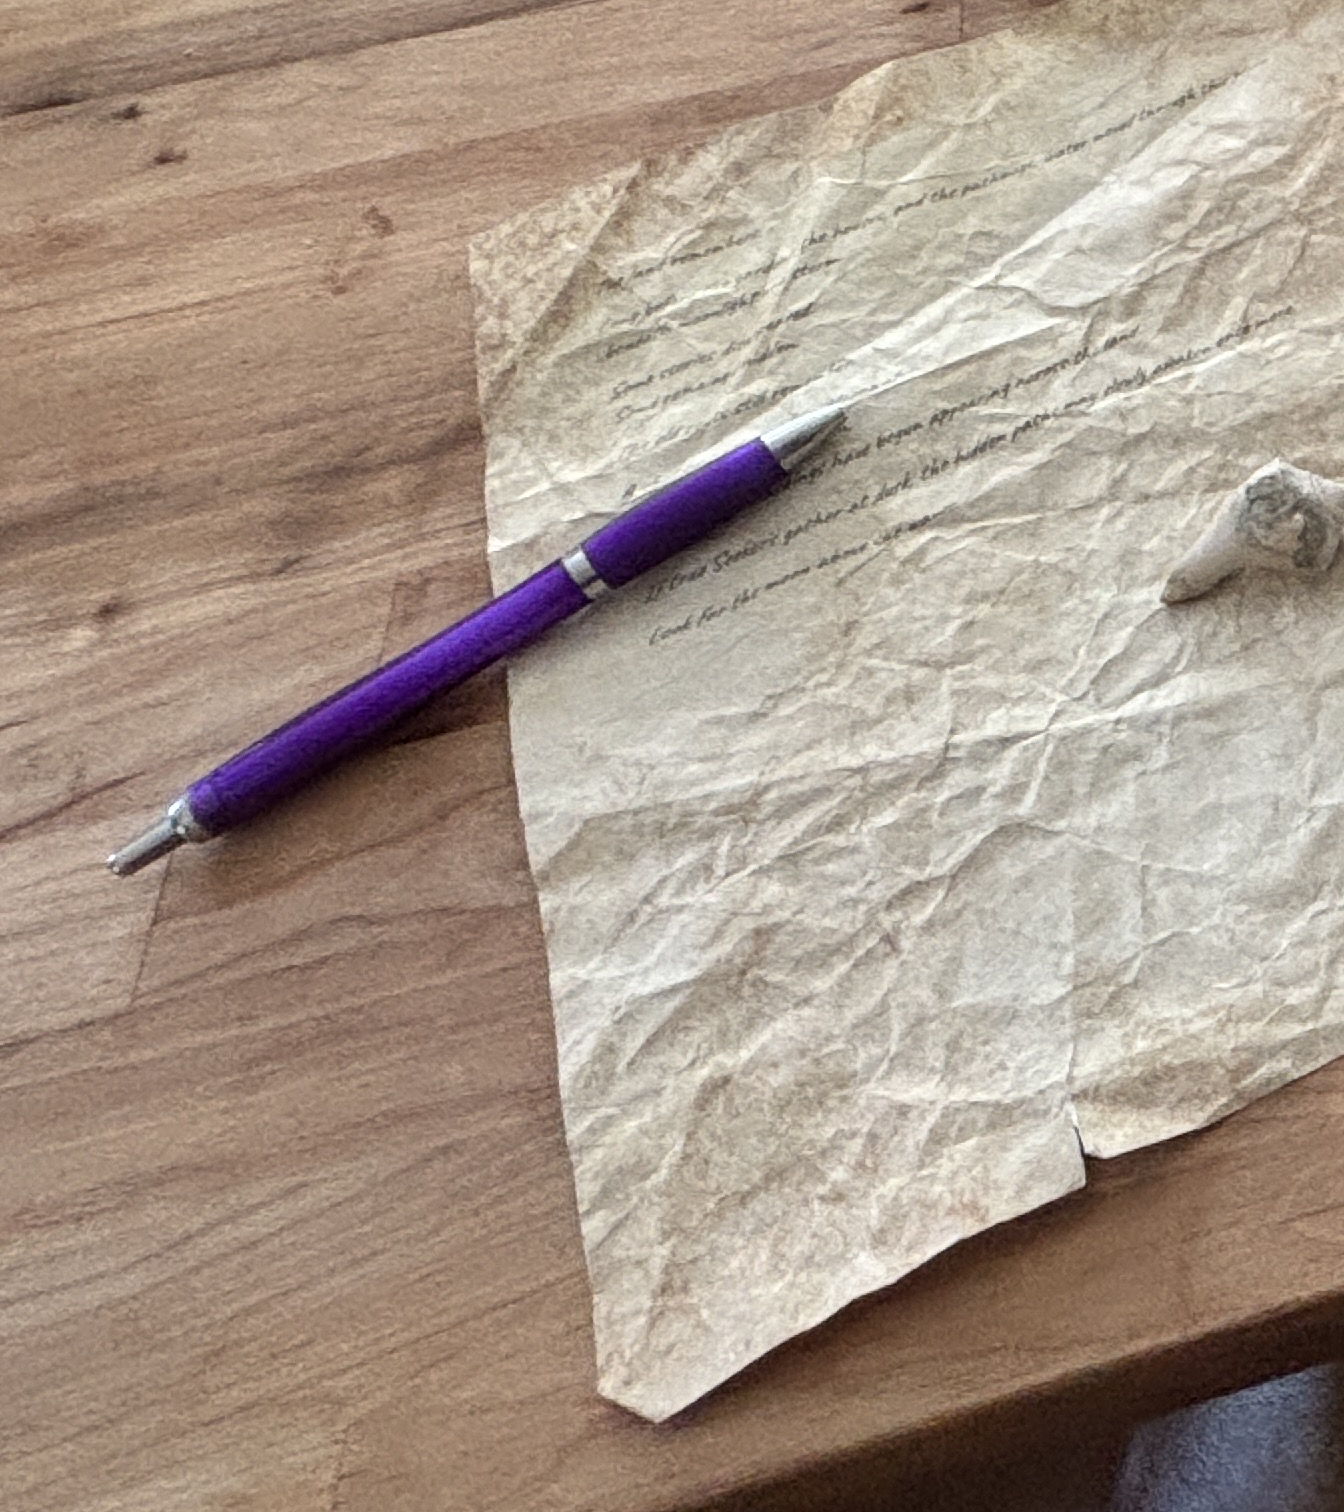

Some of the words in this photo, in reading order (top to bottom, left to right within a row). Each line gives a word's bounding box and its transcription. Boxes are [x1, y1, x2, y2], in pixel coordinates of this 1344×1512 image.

[929, 382, 1011, 426] appearing
[848, 493, 870, 514] at
[921, 460, 950, 480] the
[953, 433, 1008, 465] hidden
[732, 587, 761, 610] the
